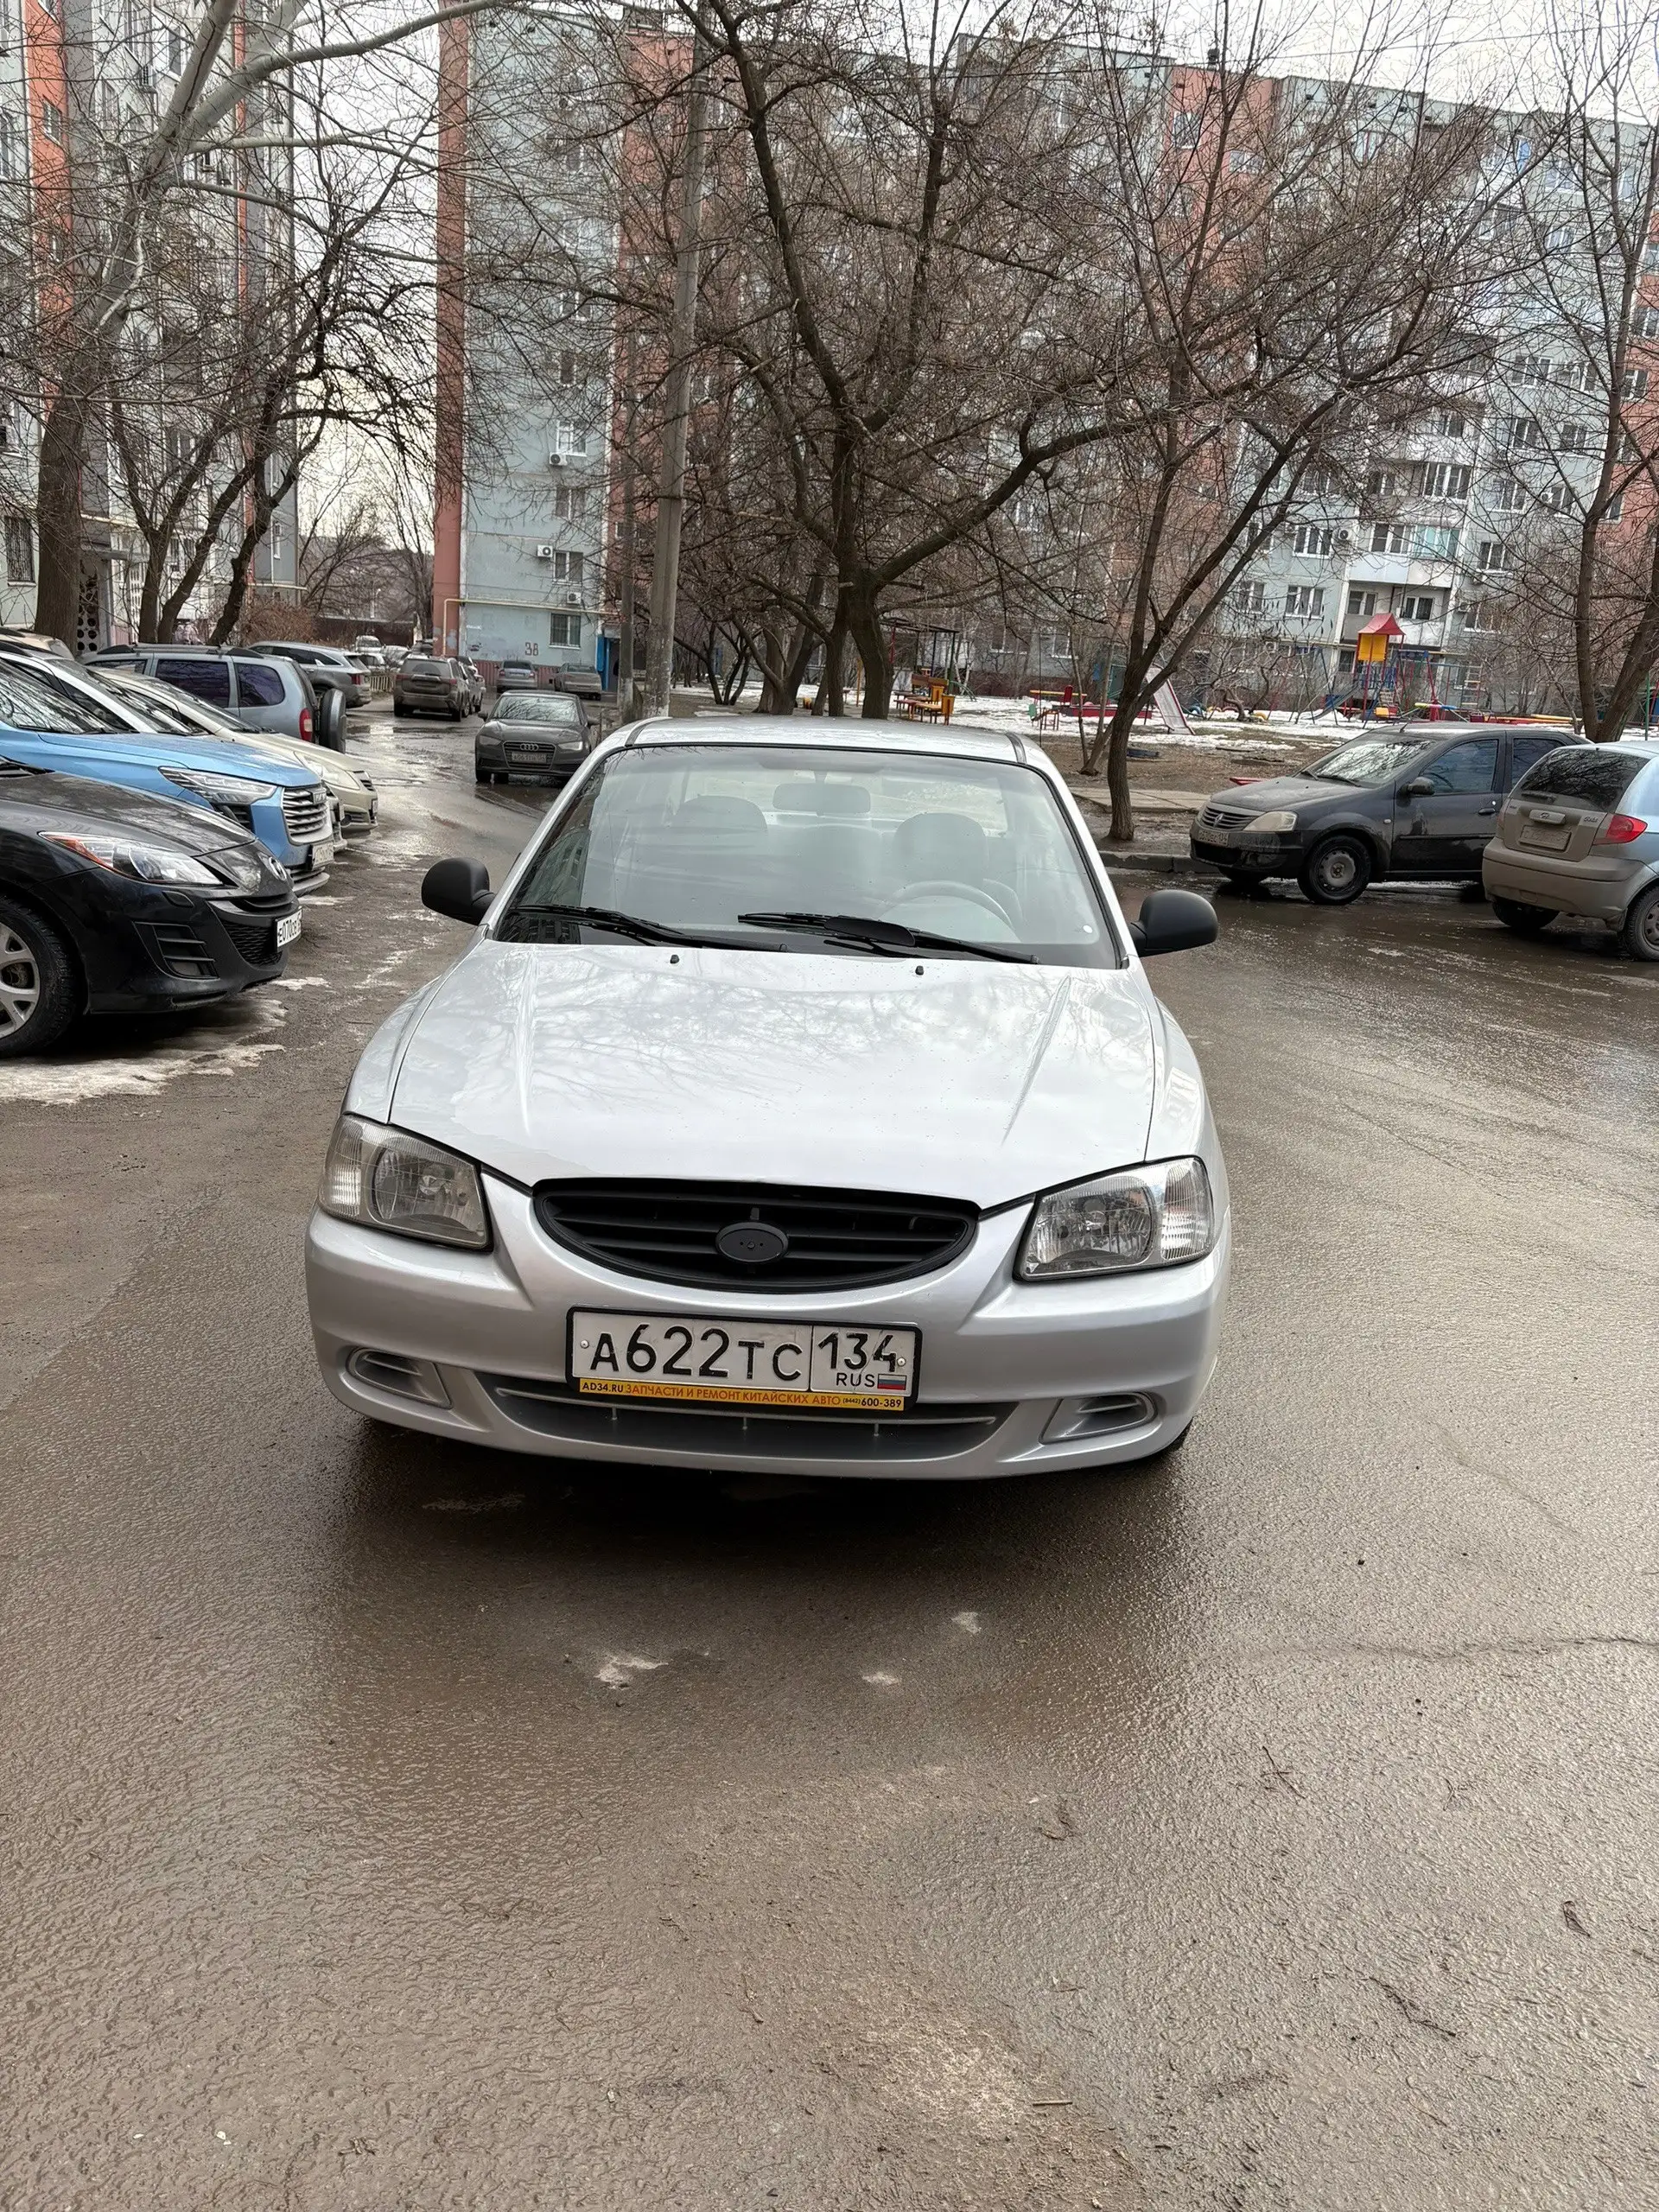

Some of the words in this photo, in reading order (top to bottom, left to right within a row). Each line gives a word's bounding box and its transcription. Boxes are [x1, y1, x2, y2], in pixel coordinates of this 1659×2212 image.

[524, 642, 539, 656] 38
[590, 1323, 803, 1381] А622ТС
[817, 1332, 897, 1372] 134
[836, 1372, 875, 1388] RUS
[582, 1382, 623, 1393] AD34.RU
[626, 1384, 683, 1397] ЗАПЧАСТИ
[687, 1388, 694, 1397] И
[696, 1389, 741, 1400] РЕМОНТ
[743, 1391, 809, 1404] КИТАЙСКИХ
[812, 1395, 841, 1405] АВТО
